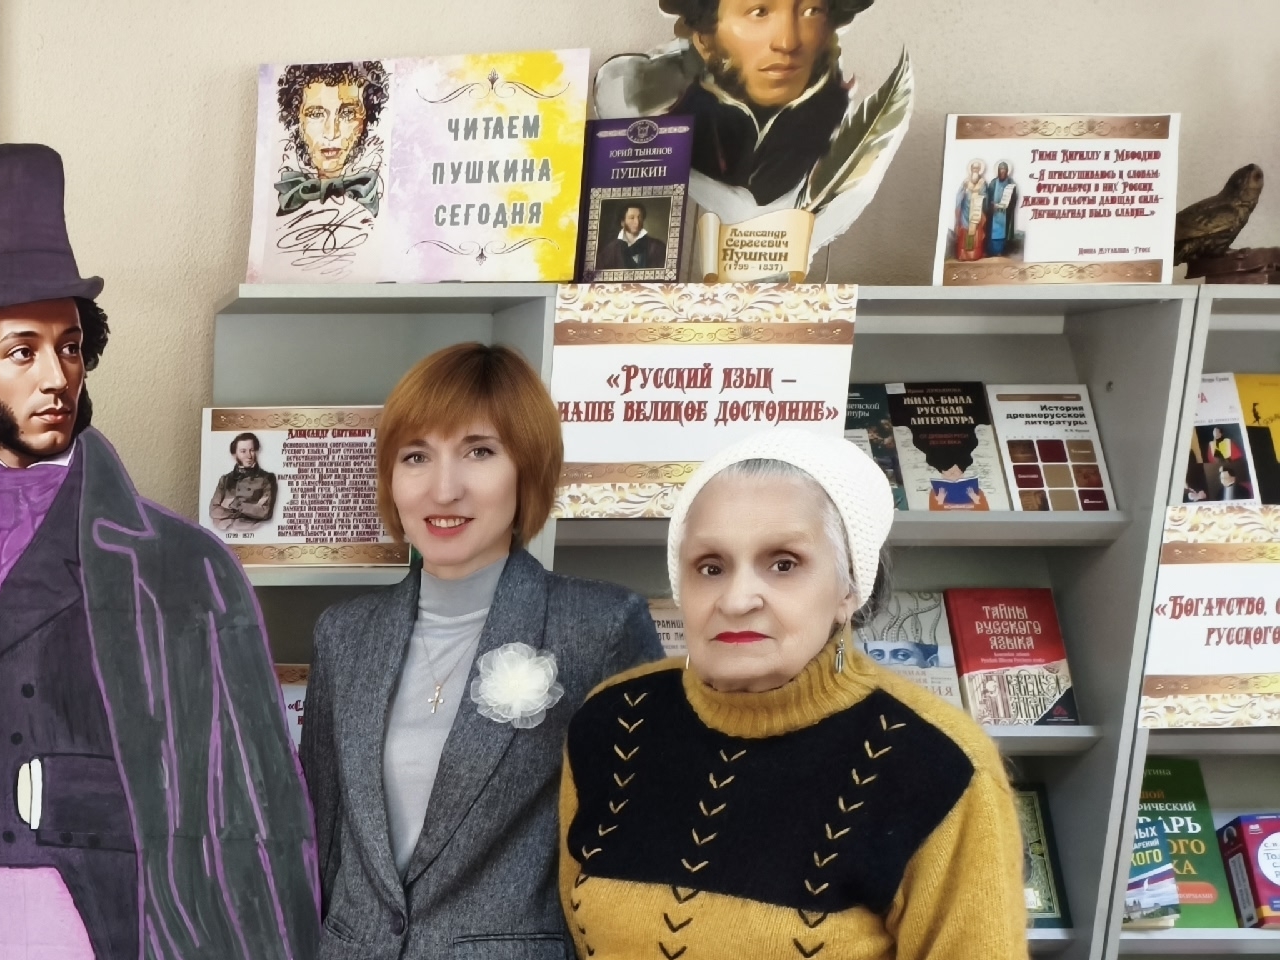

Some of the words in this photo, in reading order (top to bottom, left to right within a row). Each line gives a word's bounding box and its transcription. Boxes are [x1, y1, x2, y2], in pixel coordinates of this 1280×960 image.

[447, 114, 541, 142] ЧИТАЕМ
[609, 148, 633, 158] ЮРИЙ
[633, 146, 673, 156] ТЫНЯНОВ
[431, 158, 552, 185] ПУШКИНА
[610, 165, 668, 180] ПУШКИН
[433, 201, 543, 228] СЕГОДНЯ
[729, 228, 787, 239] Александр
[725, 238, 789, 249] Сергеевич
[721, 248, 789, 265] Пушкин
[903, 395, 973, 405] ЖИЛА-БЫЛА
[916, 406, 964, 415] РУССКАЯ
[1040, 404, 1084, 412] История
[910, 416, 975, 425] ЛИТЕРАТУРА
[1006, 411, 1087, 420] древнерусской
[982, 604, 1029, 619] ТАЙНЫ
[975, 620, 1042, 635] РУССКОГО
[990, 636, 1035, 650] ЯЗЫКА
[1141, 790, 1165, 799] ШОЙ
[1133, 838, 1160, 850] АРЕНИЙ
[1166, 839, 1206, 855] ОГО
[1172, 859, 1198, 875] КА
